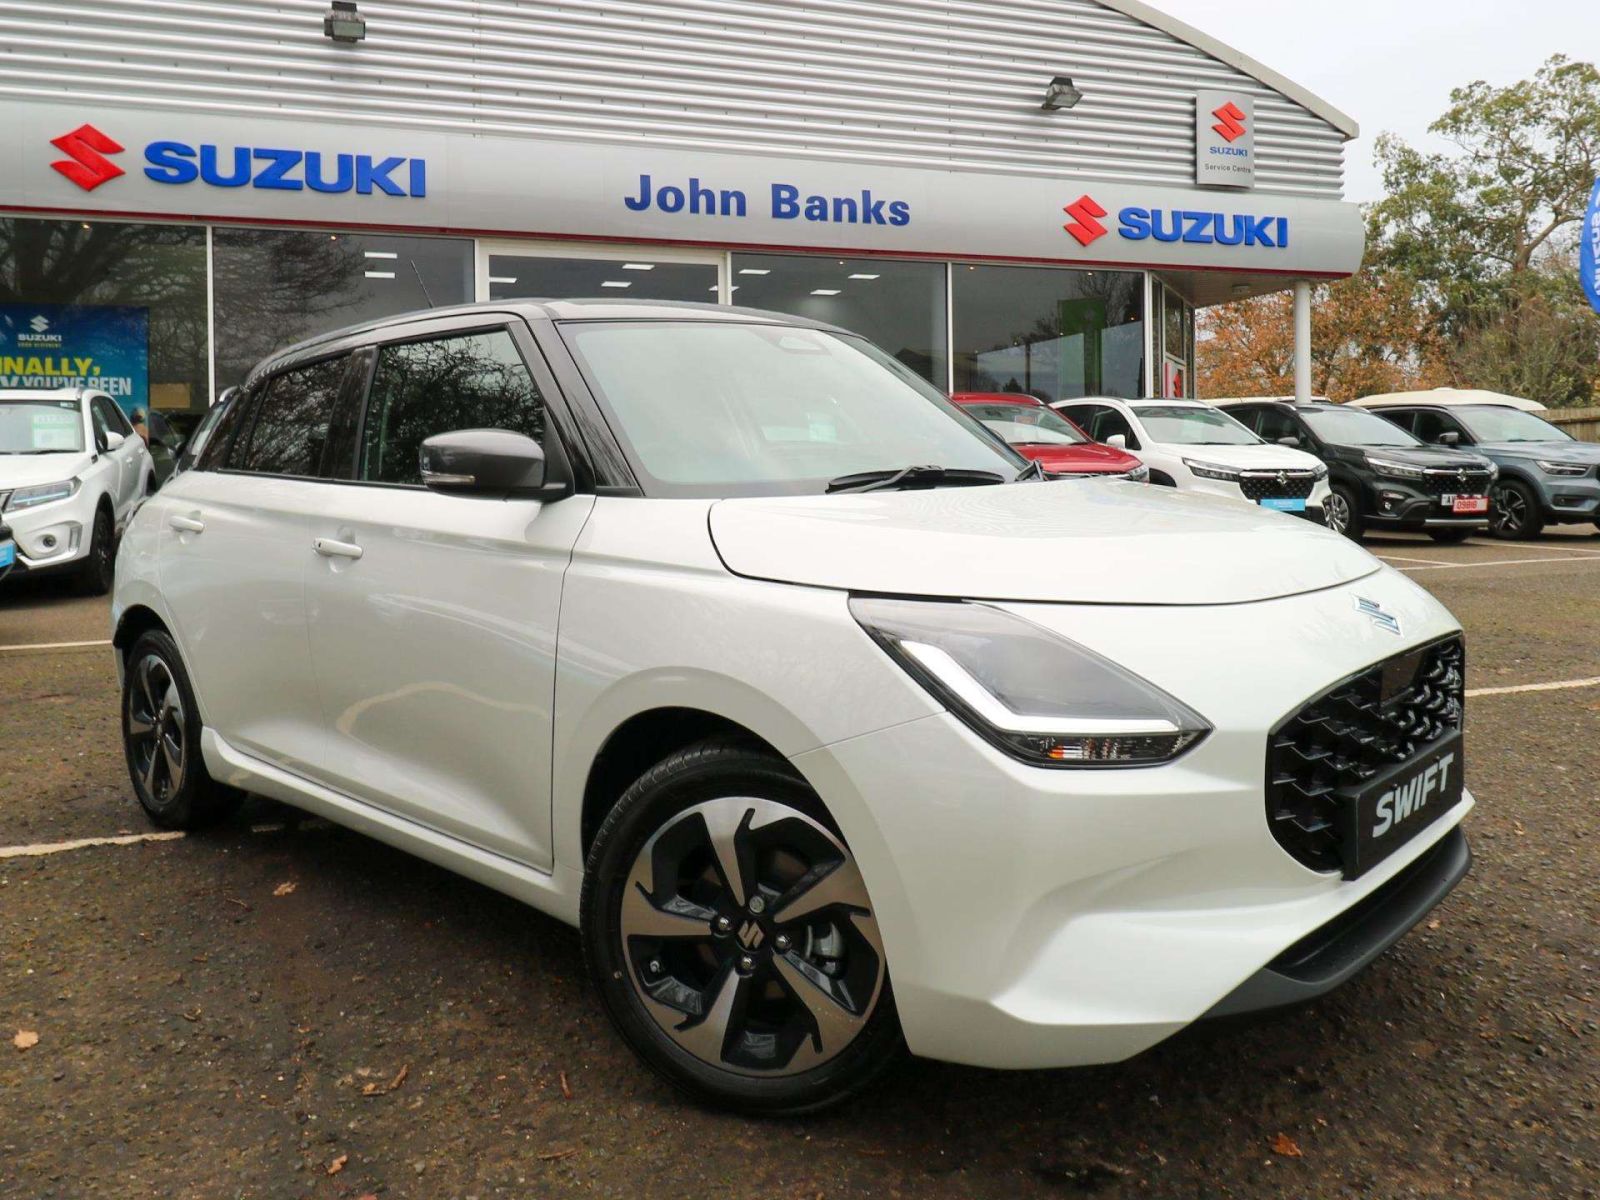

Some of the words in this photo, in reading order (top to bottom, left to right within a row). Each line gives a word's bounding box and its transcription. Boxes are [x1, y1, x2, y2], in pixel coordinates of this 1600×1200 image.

[143, 141, 426, 198] SUZUKI
[1204, 163, 1231, 172] Service
[1232, 165, 1251, 174] Centre
[1209, 146, 1248, 157] SUZUKI
[624, 174, 747, 217] John
[771, 183, 911, 227] Banks
[1118, 206, 1288, 248] SUZUKI
[1372, 753, 1454, 838] SWIFT
